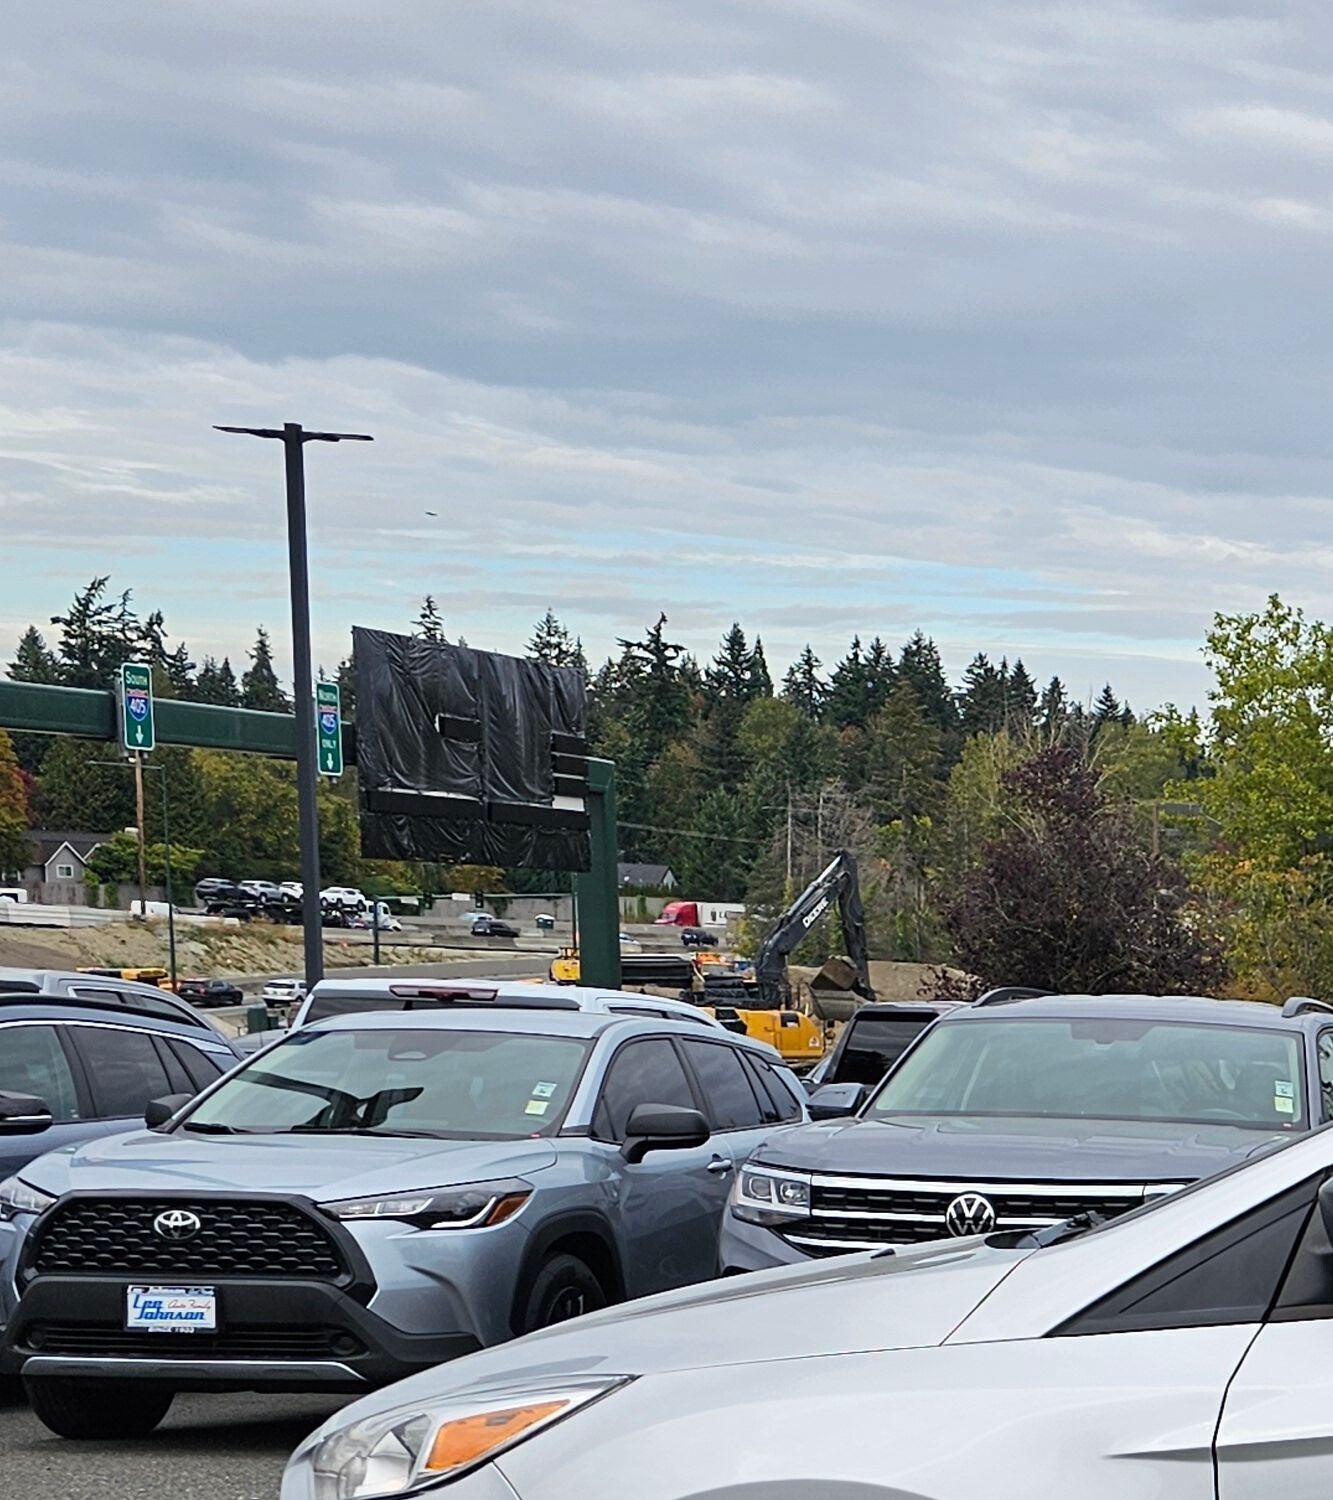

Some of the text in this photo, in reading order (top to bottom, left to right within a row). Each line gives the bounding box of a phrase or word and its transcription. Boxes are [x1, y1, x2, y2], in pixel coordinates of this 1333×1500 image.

[130, 697, 146, 714] 405
[133, 1294, 164, 1309] Lee
[134, 1307, 206, 1320] Johnson
